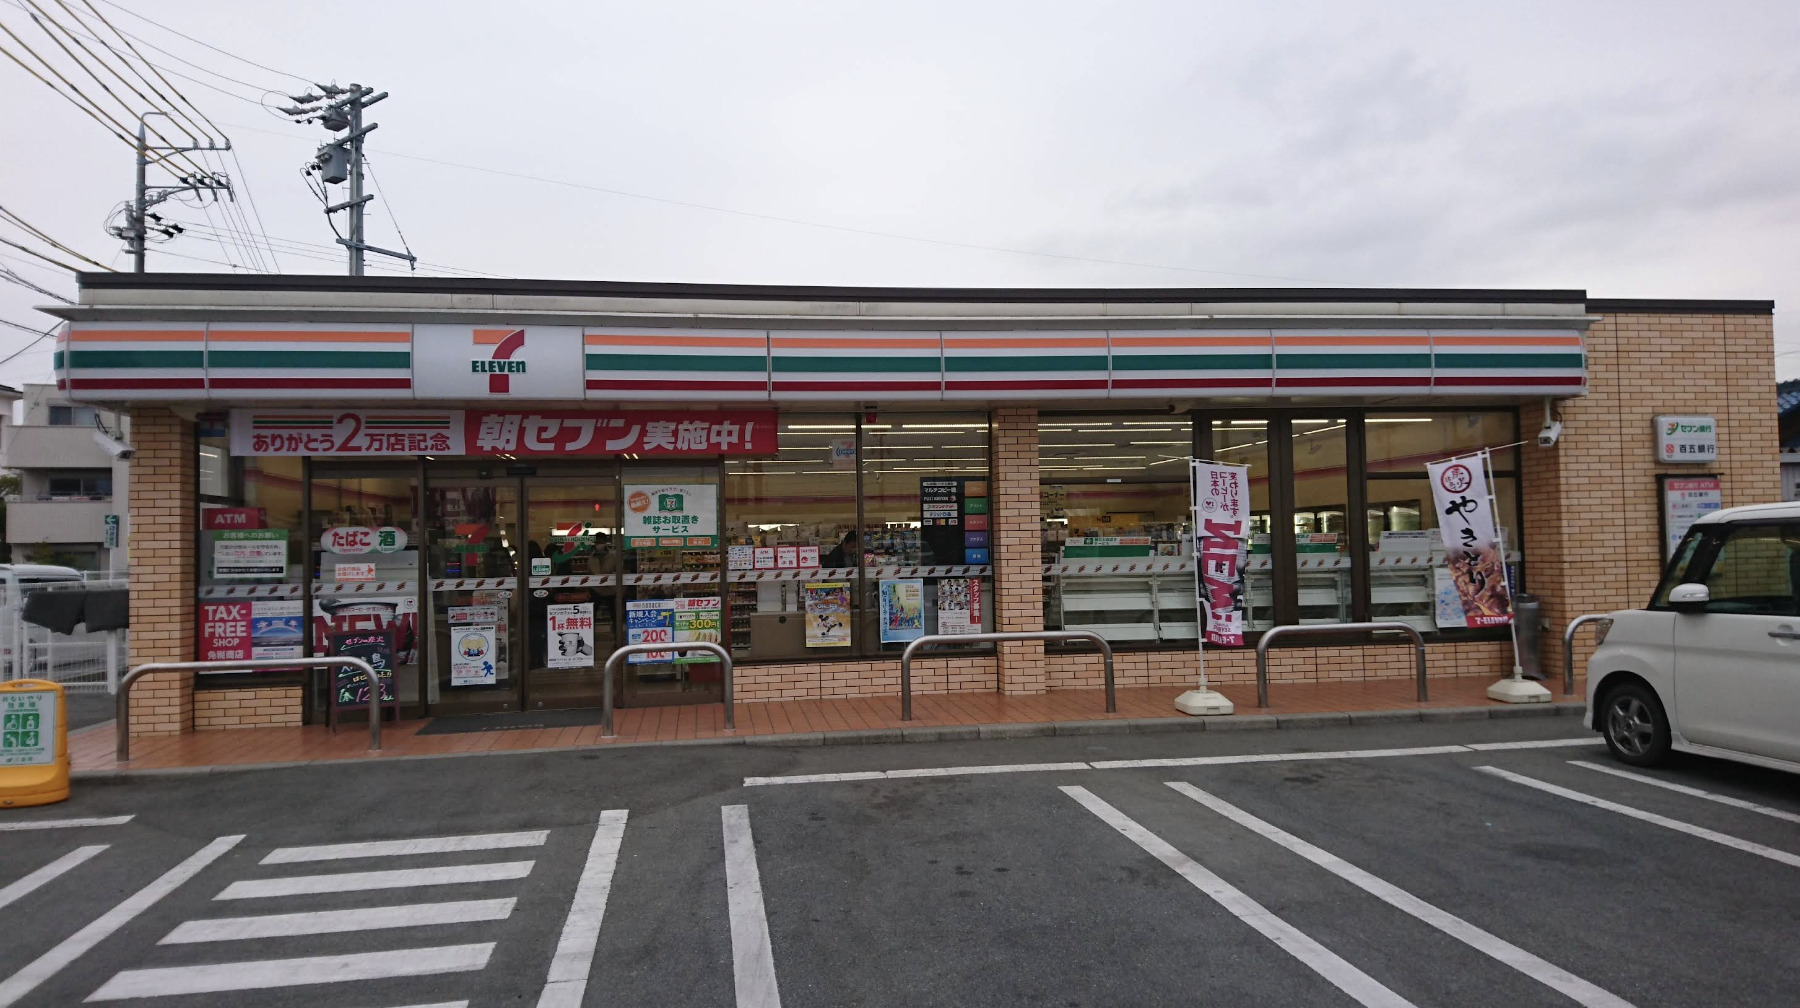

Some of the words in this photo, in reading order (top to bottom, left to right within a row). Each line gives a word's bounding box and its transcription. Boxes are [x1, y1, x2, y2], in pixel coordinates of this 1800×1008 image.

[252, 413, 451, 453] ありがとう2万店記念
[1681, 425, 1712, 433] セブン銀行
[1680, 444, 1715, 454] 百五銀行
[214, 513, 247, 524] ATM
[642, 515, 699, 525] 雑誌お取置き
[652, 525, 689, 534] サービス
[331, 531, 372, 547] たばこ
[379, 530, 396, 547] 酒
[204, 605, 247, 621] TAX-
[629, 610, 658, 618] 新規入会
[204, 621, 248, 637] FREE
[549, 616, 592, 631] 1杯無料
[212, 638, 241, 648] SHOP
